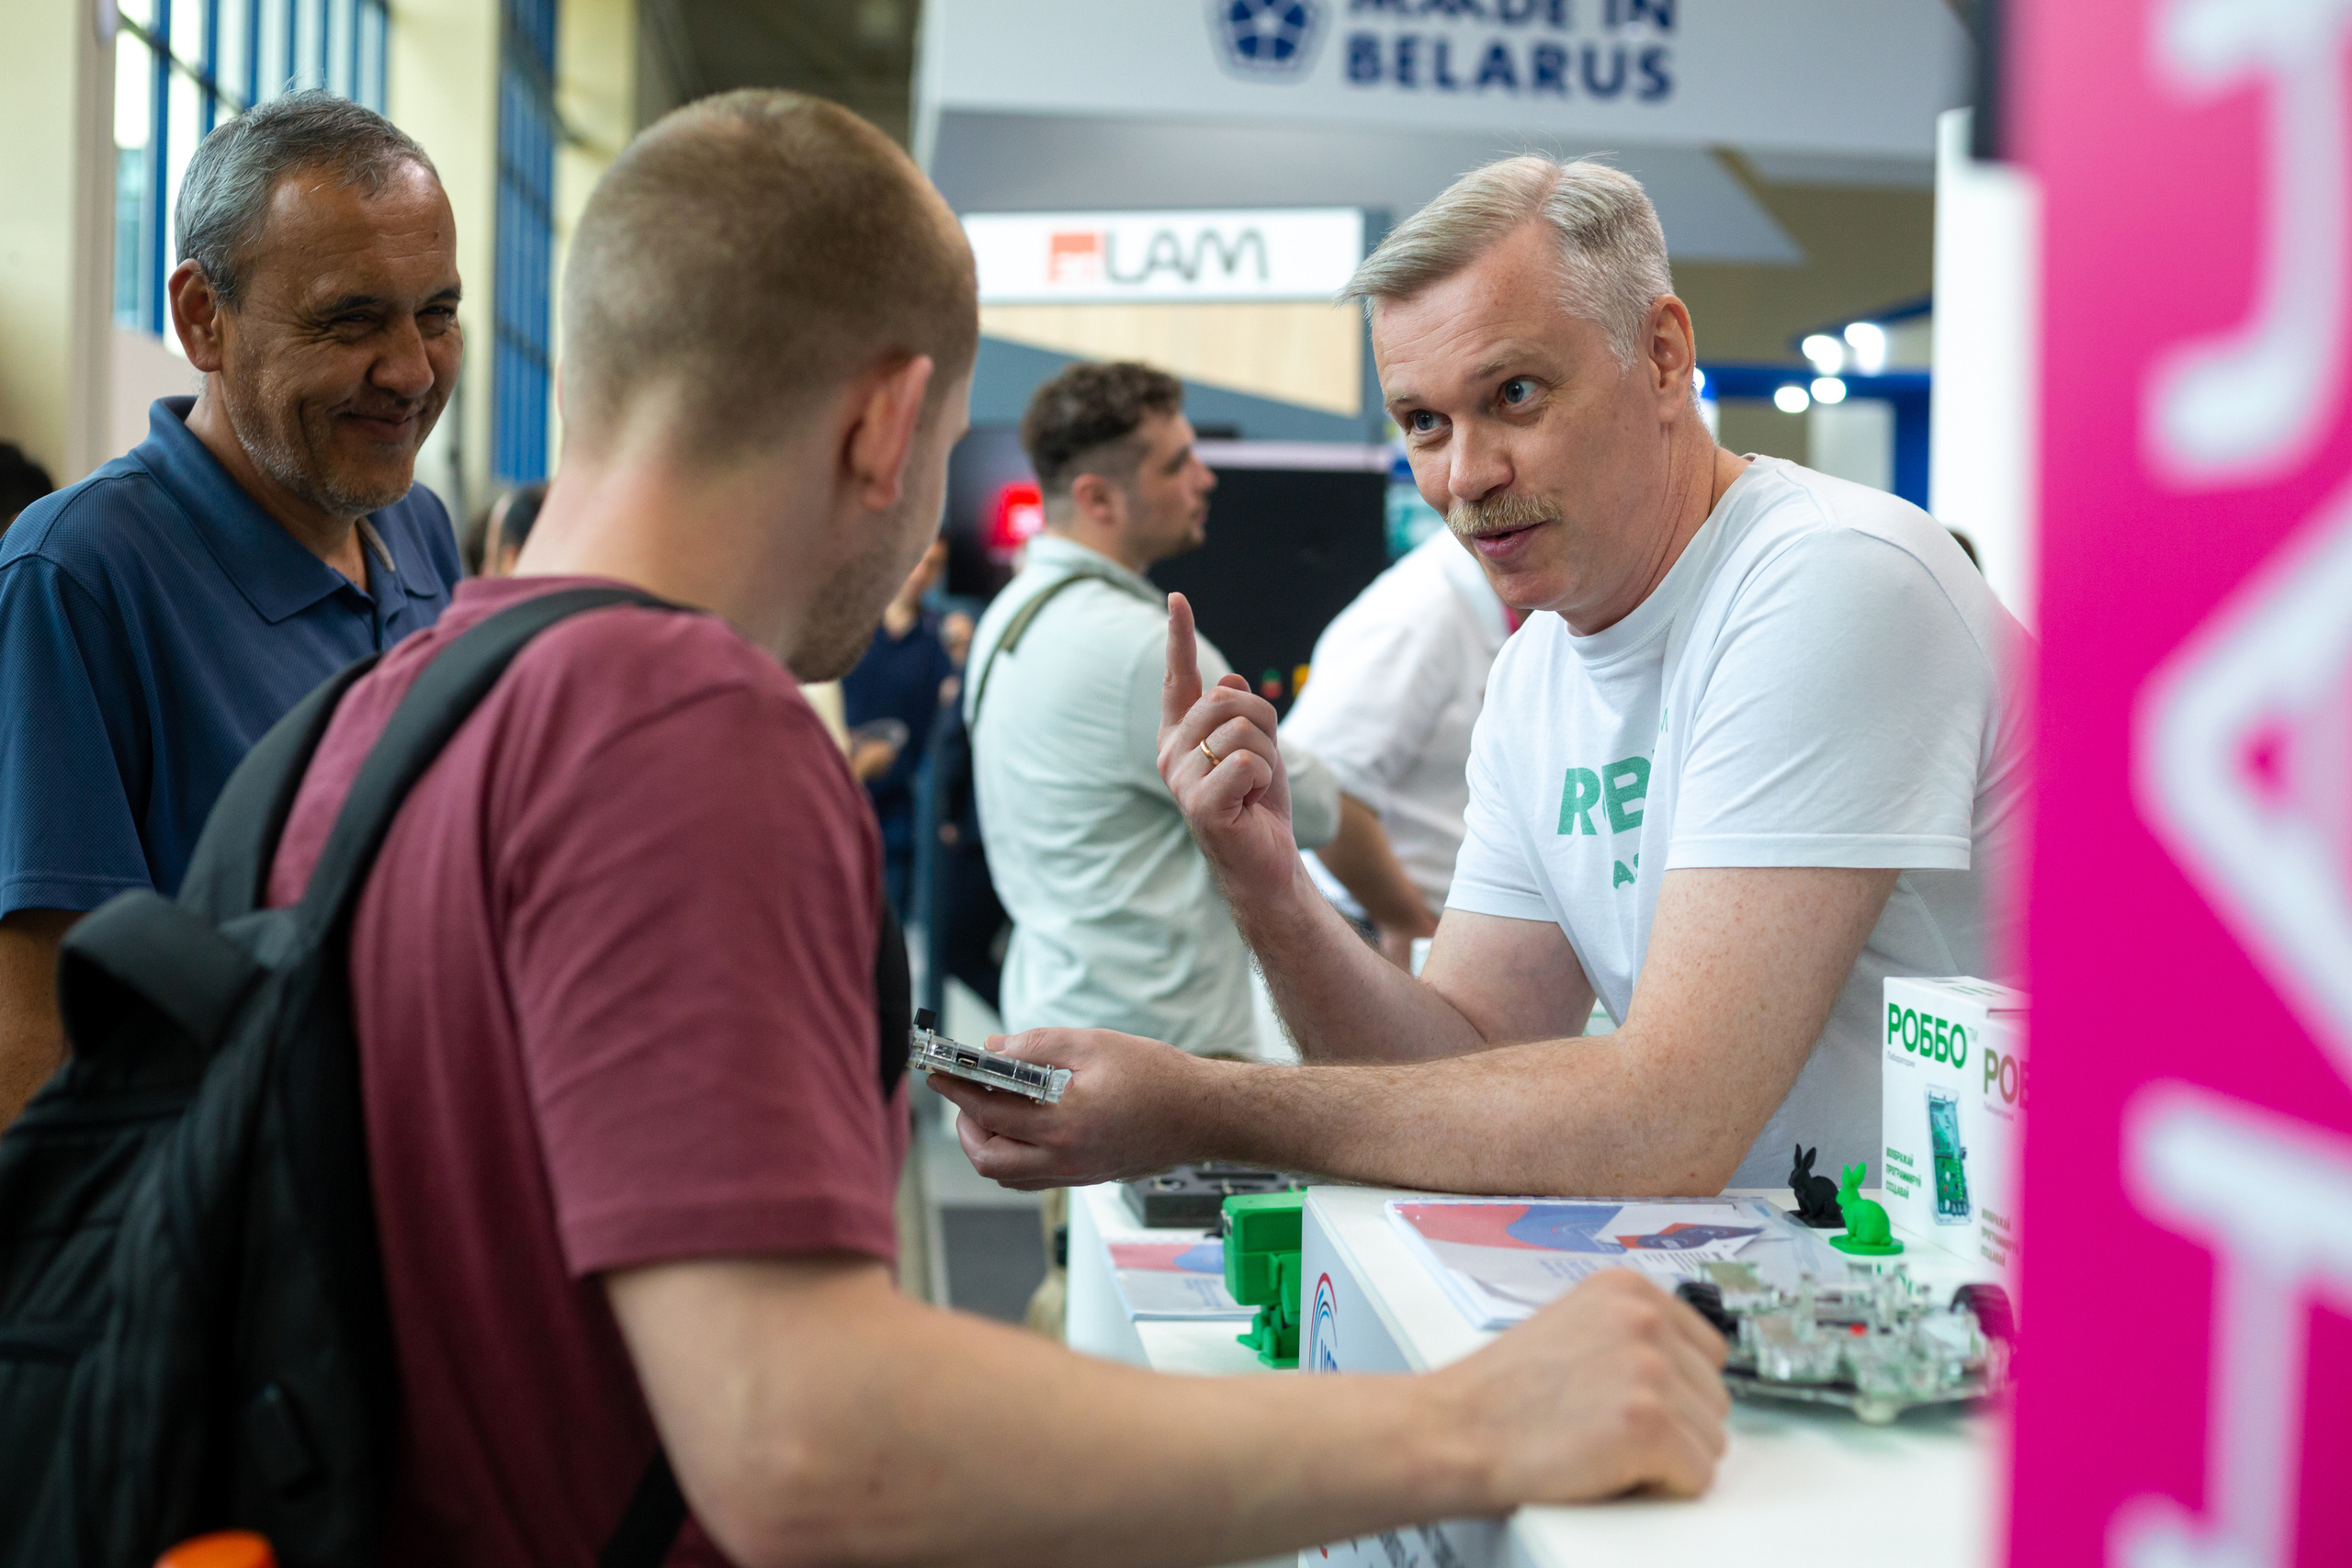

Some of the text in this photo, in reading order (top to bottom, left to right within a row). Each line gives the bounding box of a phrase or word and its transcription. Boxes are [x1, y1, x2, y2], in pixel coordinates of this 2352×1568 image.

[1345, 0, 1569, 29] DE
[1345, 32, 1673, 101] BELARUS
[1105, 228, 1269, 284] LAM
[1888, 1002, 1967, 1068] РОББО
